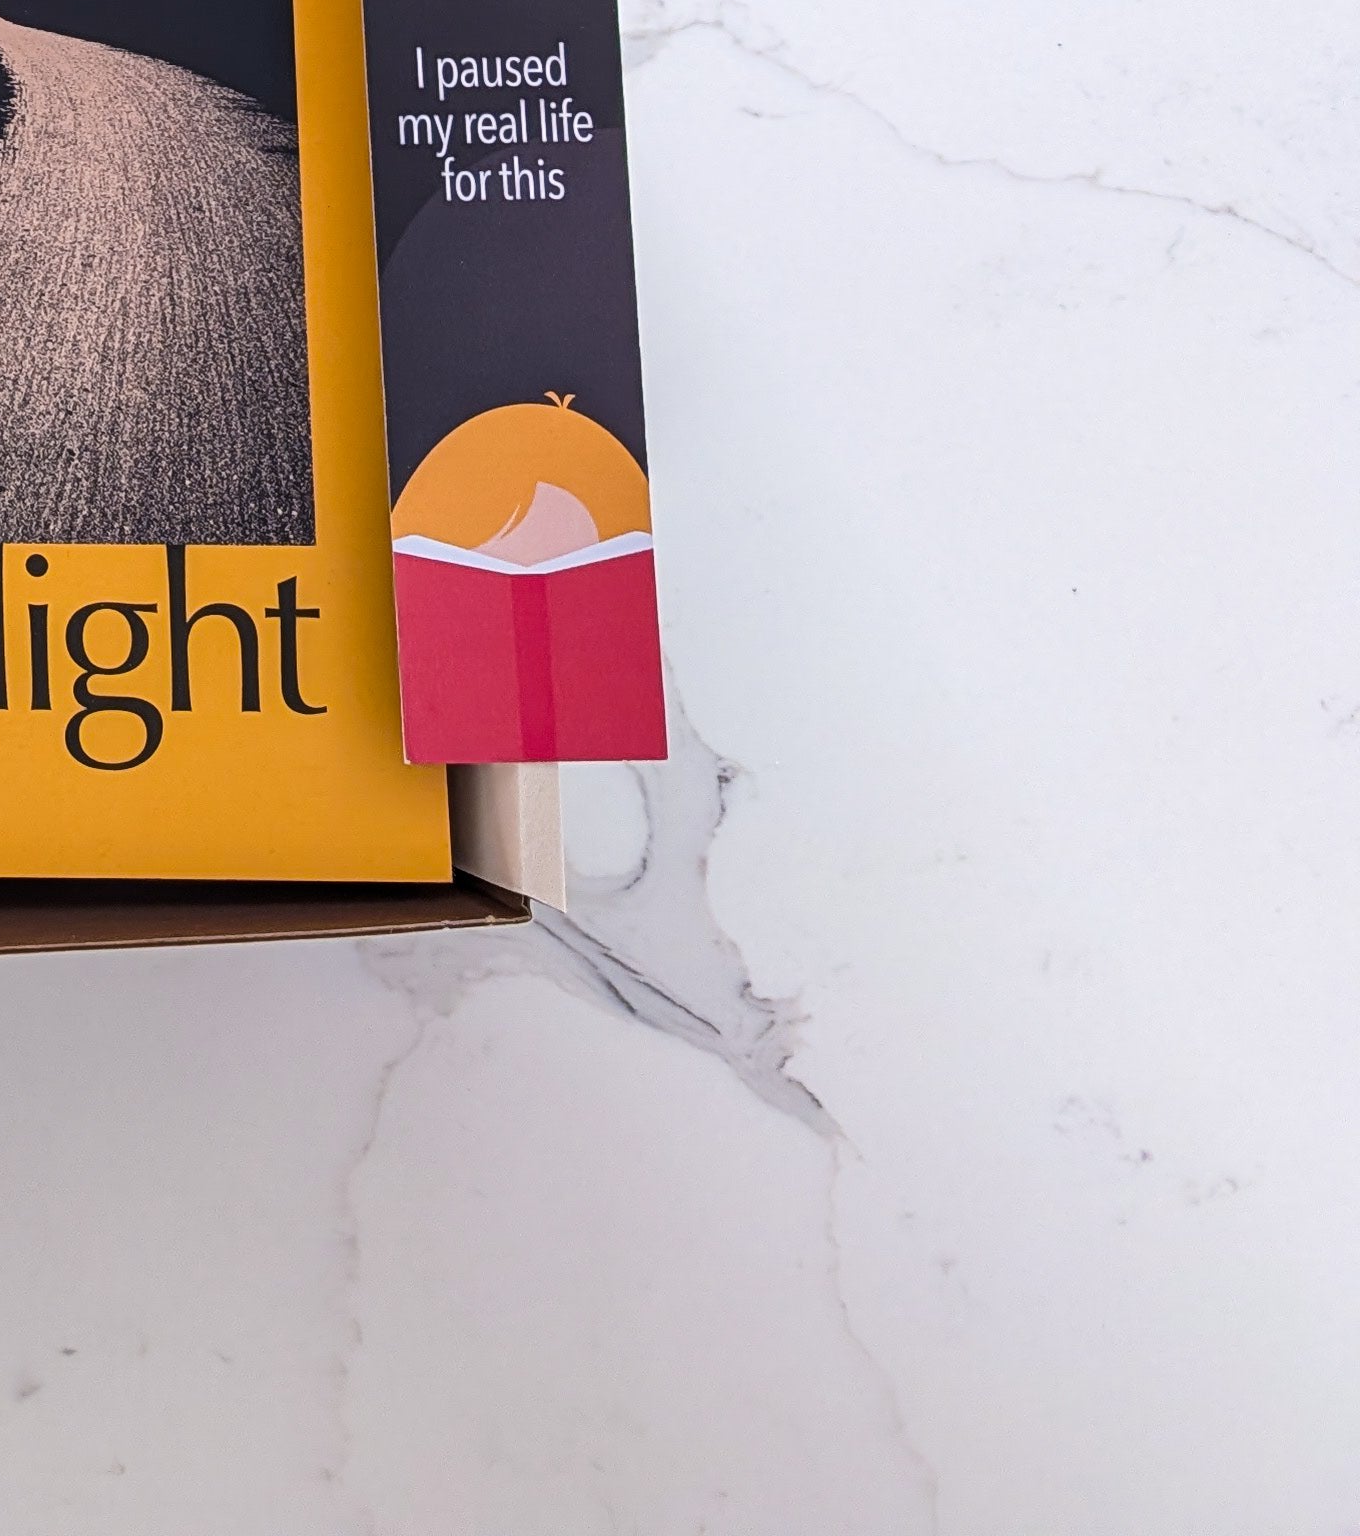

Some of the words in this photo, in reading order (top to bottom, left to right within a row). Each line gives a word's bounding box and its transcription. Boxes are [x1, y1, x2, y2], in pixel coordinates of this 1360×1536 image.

[416, 47, 424, 88] I
[437, 41, 567, 101] paused
[398, 114, 454, 158] my
[465, 99, 528, 144] real
[539, 98, 593, 143] life
[441, 156, 491, 202] for
[498, 155, 565, 200] this
